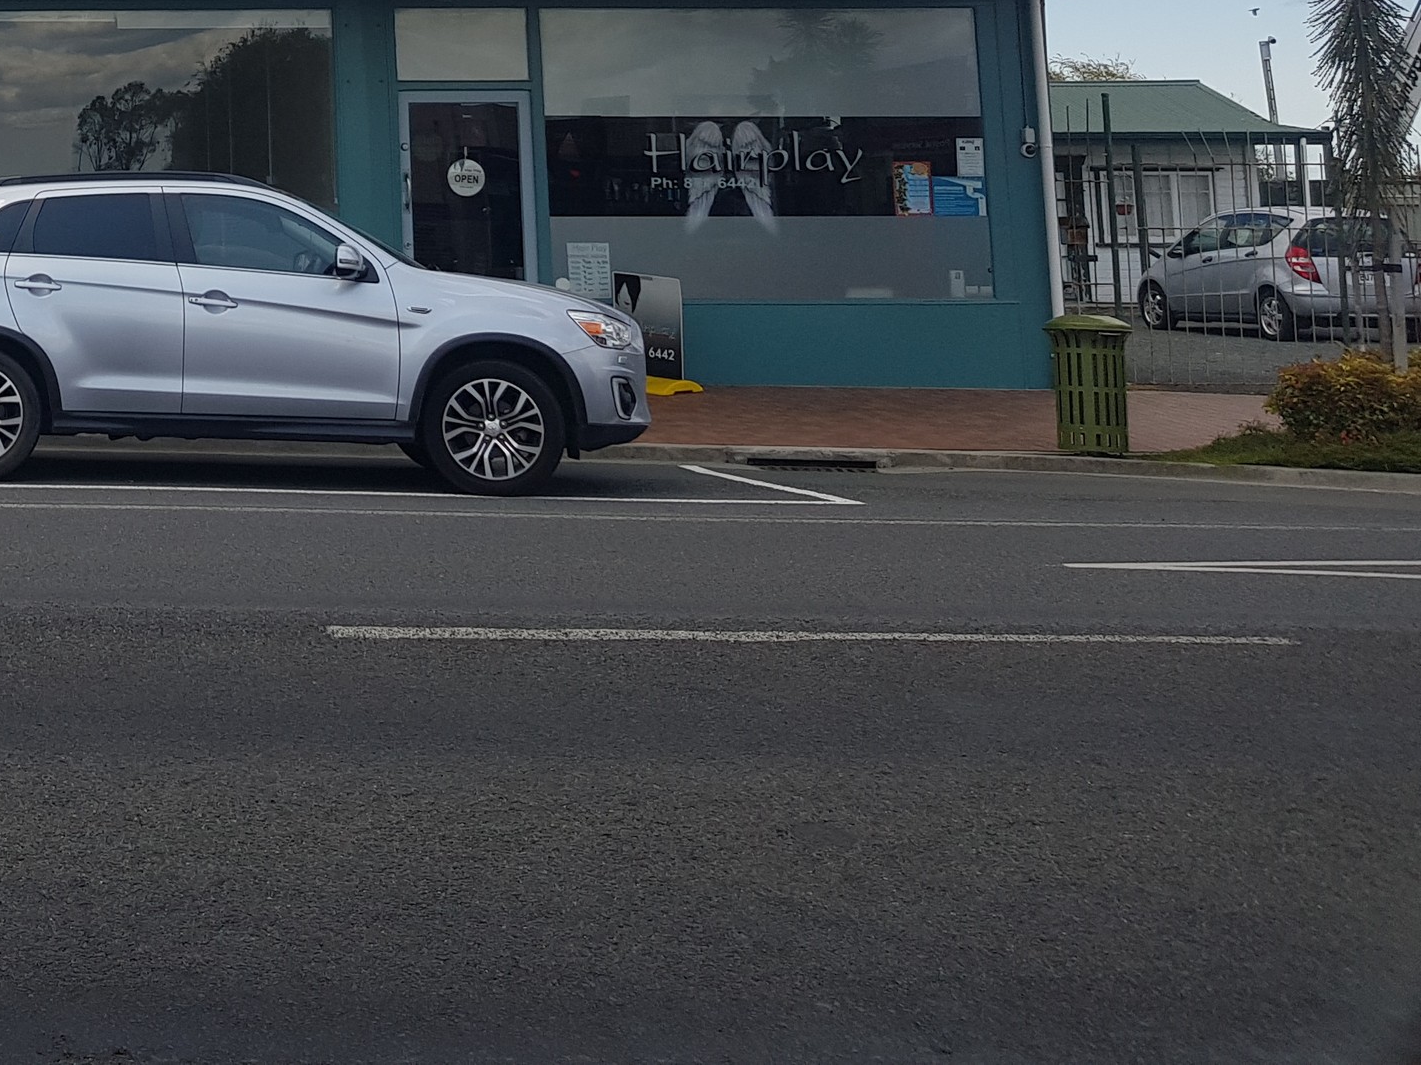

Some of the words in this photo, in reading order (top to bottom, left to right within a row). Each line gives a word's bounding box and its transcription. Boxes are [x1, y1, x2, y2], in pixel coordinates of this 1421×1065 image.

[644, 130, 863, 185] Hairplay
[454, 174, 479, 184] OPEN
[651, 177, 678, 189] Ph:
[718, 177, 756, 189] 6442
[649, 347, 675, 361] 6442
